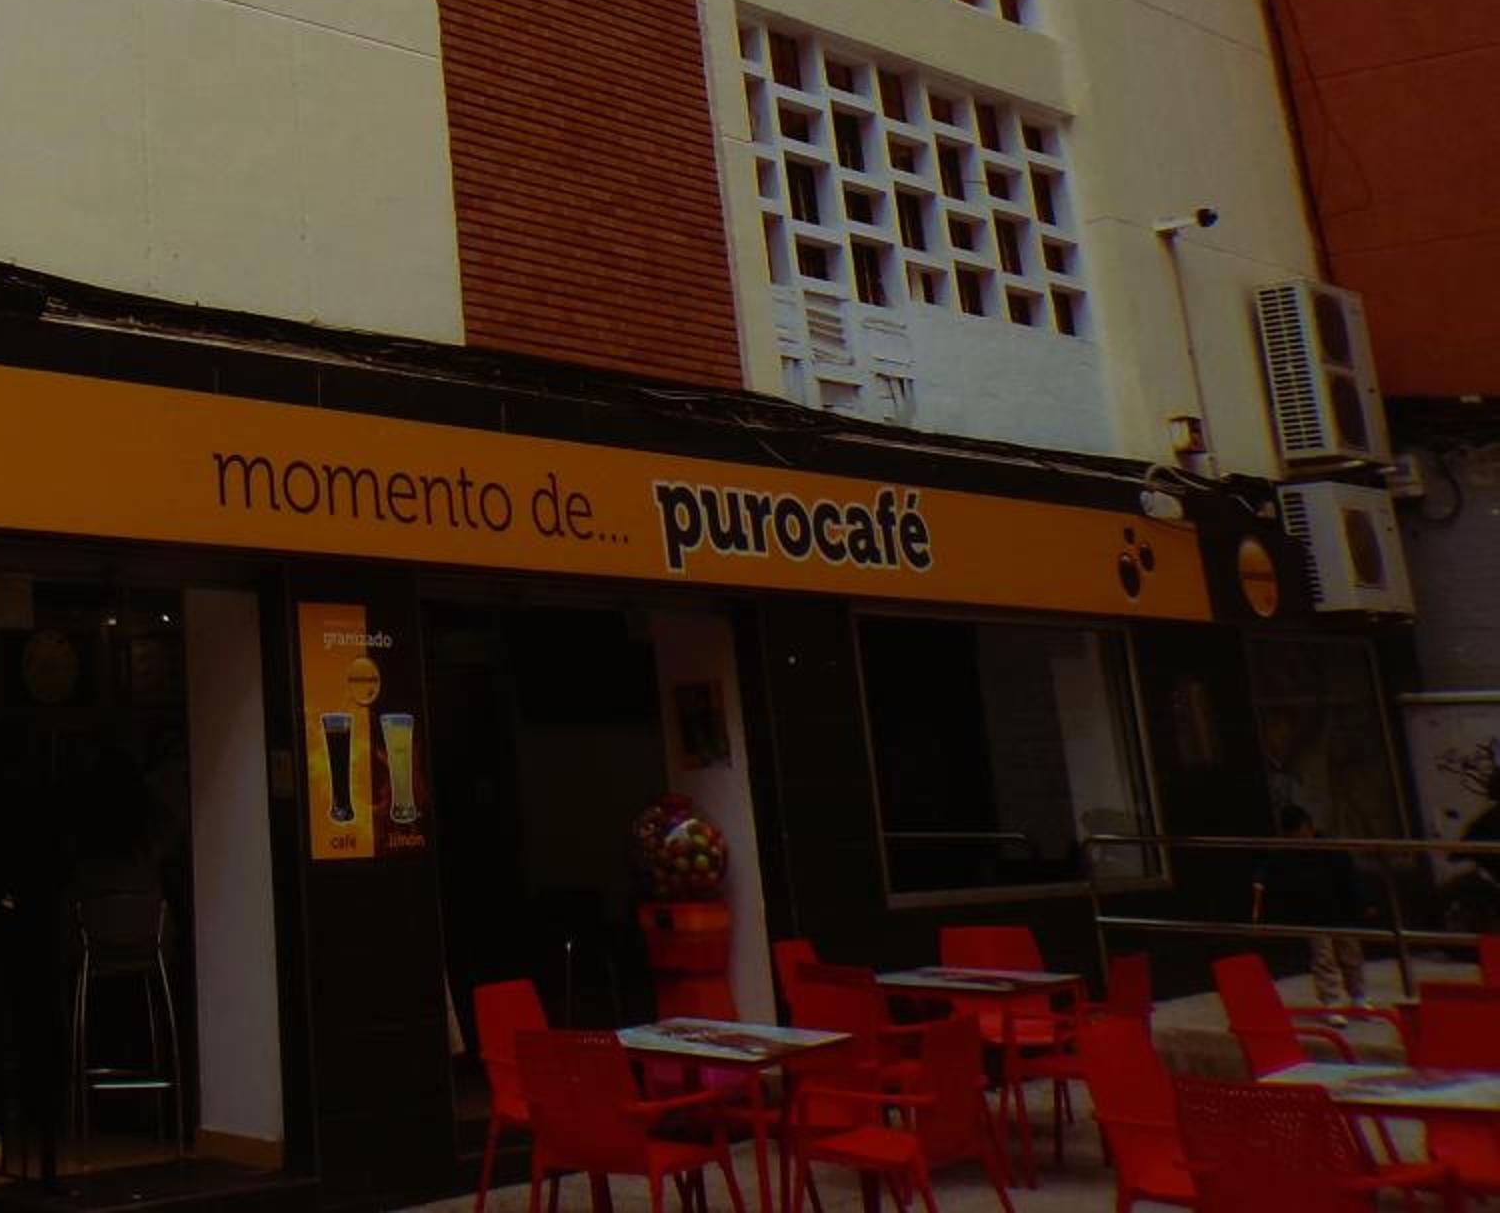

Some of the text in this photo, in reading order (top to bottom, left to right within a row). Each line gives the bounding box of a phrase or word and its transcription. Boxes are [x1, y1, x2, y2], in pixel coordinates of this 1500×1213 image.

[213, 452, 934, 572] momento de... purocafé
